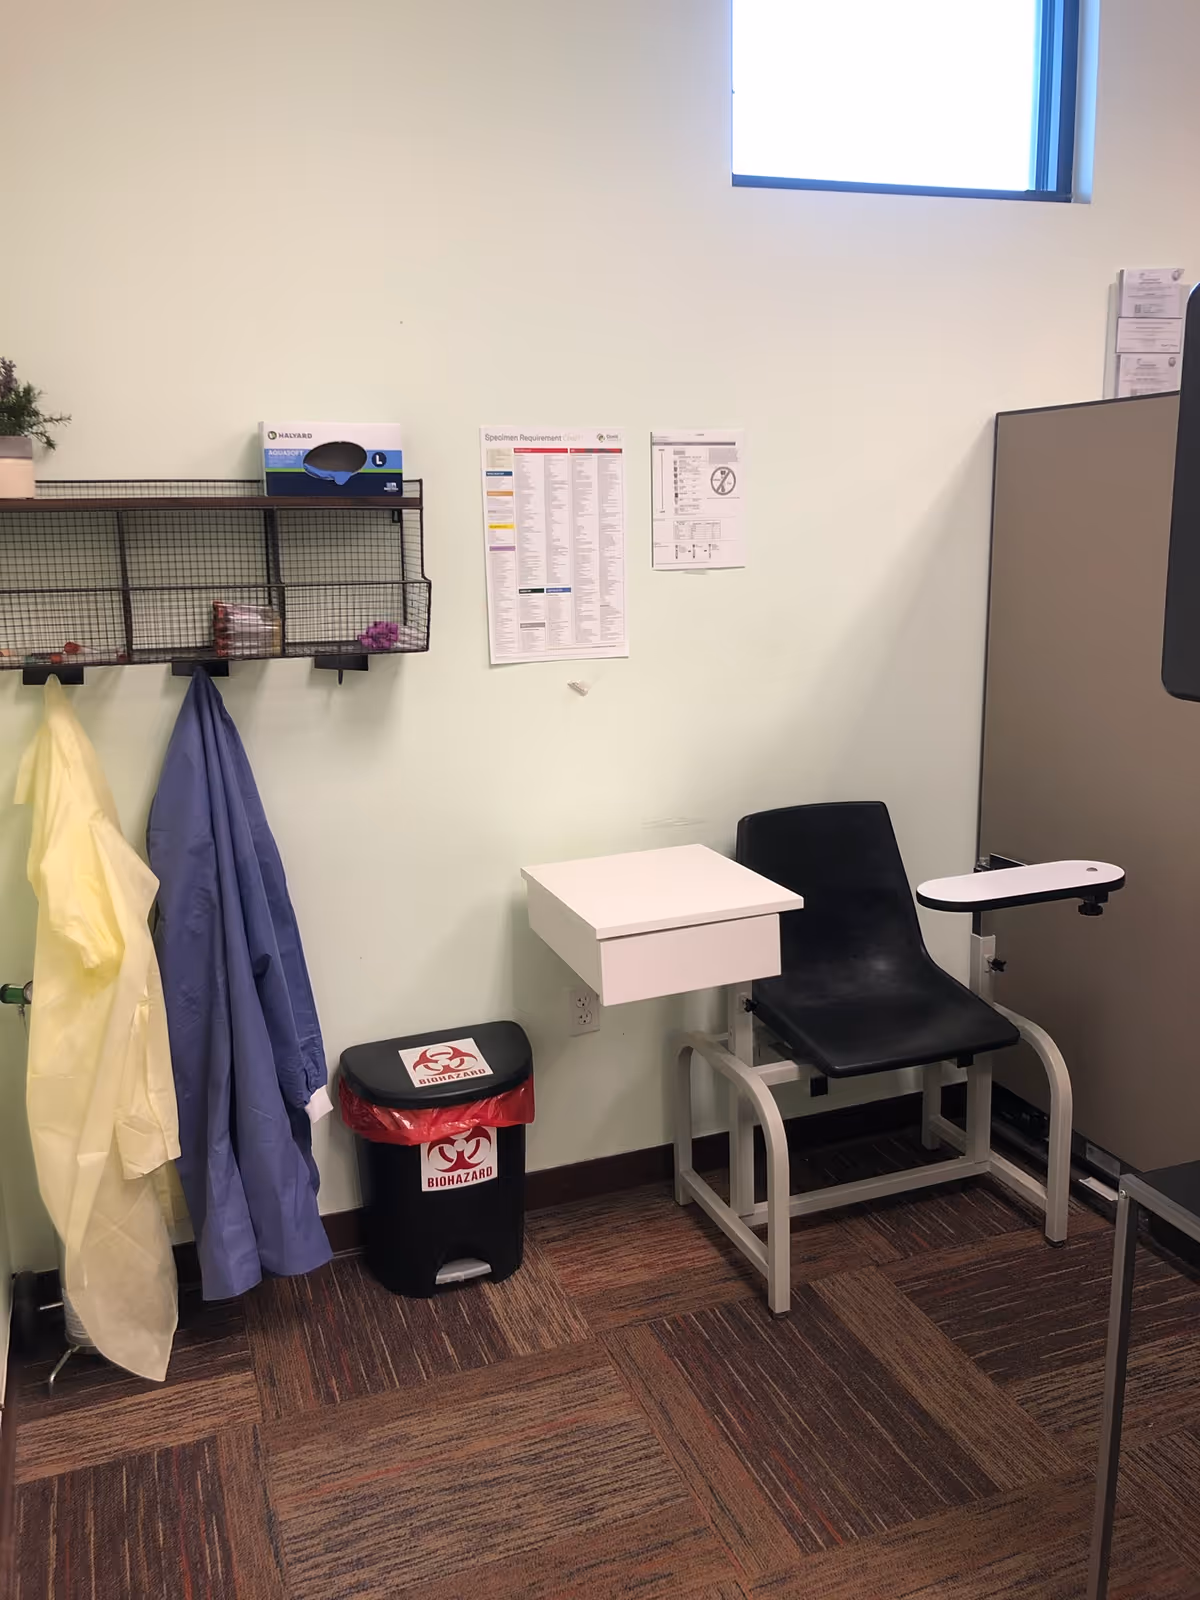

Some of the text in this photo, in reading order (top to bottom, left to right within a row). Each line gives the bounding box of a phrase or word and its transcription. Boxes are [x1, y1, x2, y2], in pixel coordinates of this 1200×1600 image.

[484, 433, 519, 442] Specimen
[519, 434, 562, 442] Requirement
[375, 454, 383, 465] L
[418, 1068, 486, 1085] BIOHAZARD
[427, 1166, 493, 1188] BIOHAZARD
